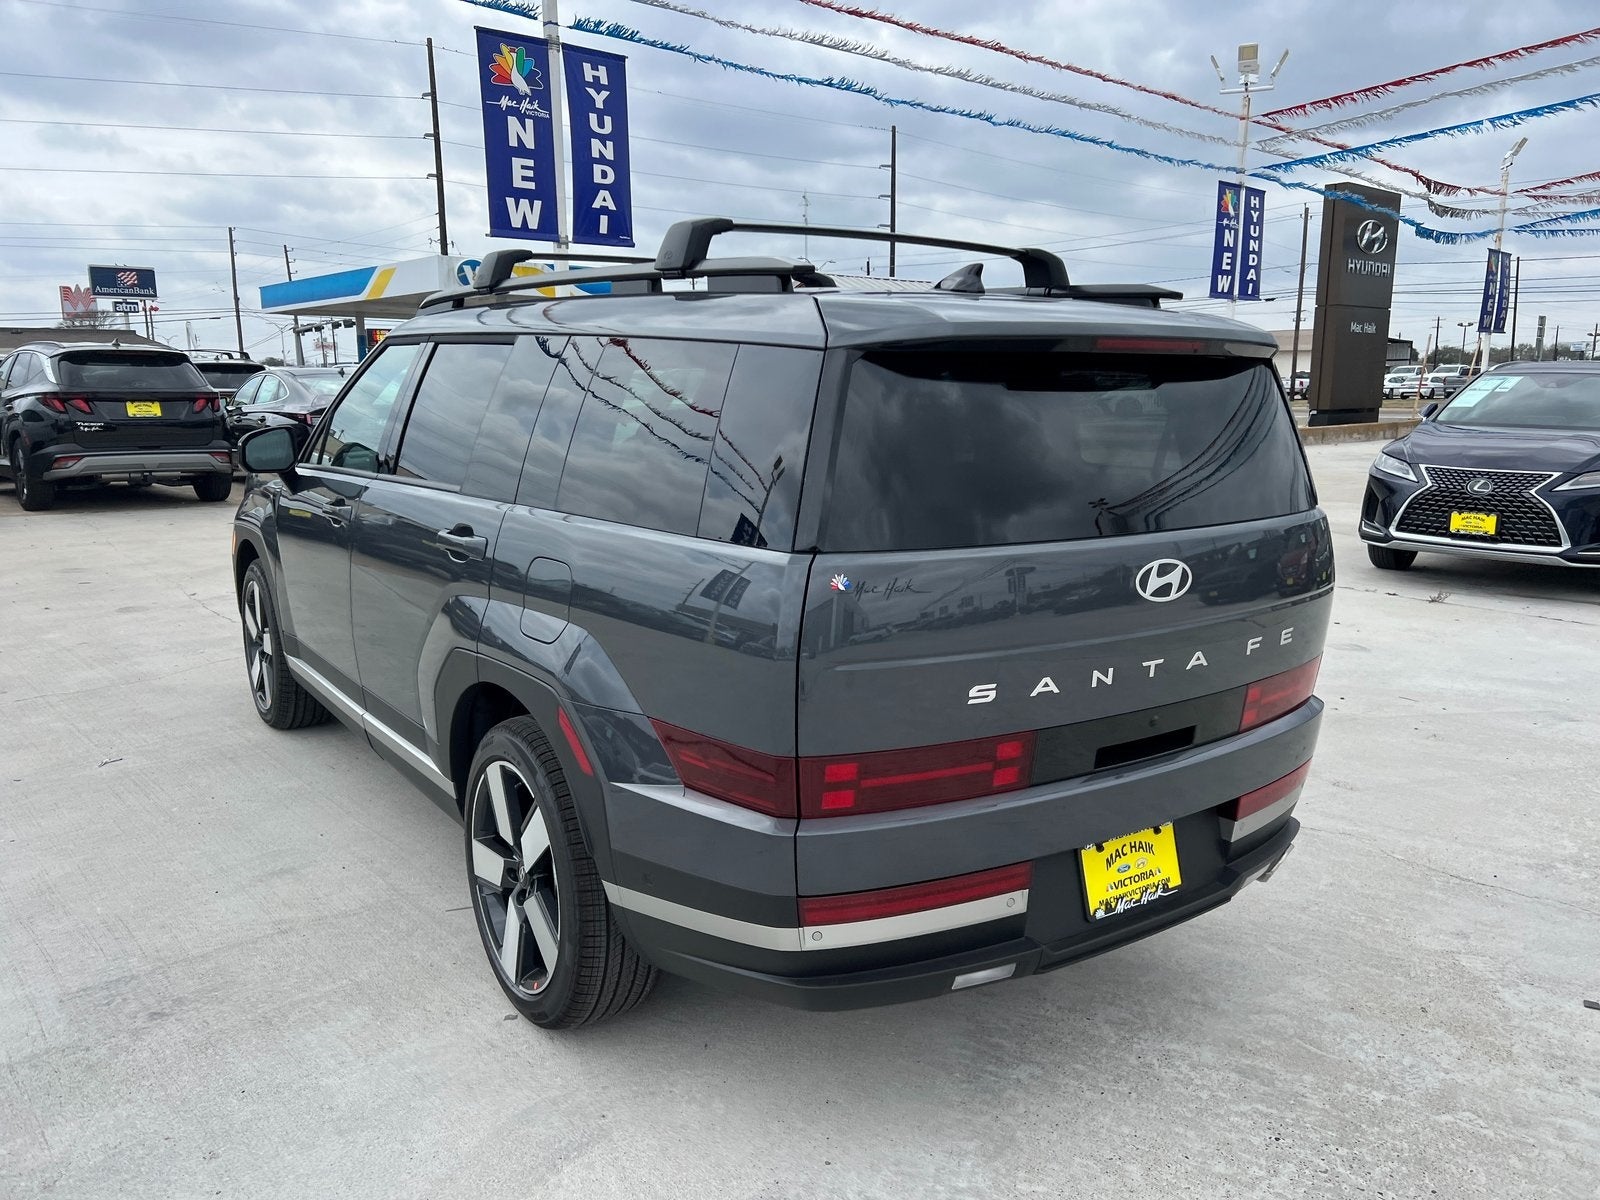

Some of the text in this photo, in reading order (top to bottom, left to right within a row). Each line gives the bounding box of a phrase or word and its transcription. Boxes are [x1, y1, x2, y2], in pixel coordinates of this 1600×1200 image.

[488, 95, 549, 114] Mac Haik
[525, 110, 550, 119] VICTORIA
[582, 62, 617, 234] HYUNDAI
[505, 115, 542, 230] NEW
[1246, 195, 1260, 295] HYUNDAI
[1217, 229, 1235, 293] NEW
[1347, 258, 1391, 277] HYUNDAI
[95, 285, 155, 295] AmericanBank
[1483, 282, 1496, 328] NEW
[1499, 256, 1510, 329] HYUNDAI
[115, 303, 138, 312] atm
[1350, 321, 1377, 334] Mac Haik
[850, 577, 931, 601] Mac Haik
[967, 627, 1294, 705] SANTA FE
[1105, 843, 1127, 871] MAC
[1129, 840, 1155, 856] HAIK
[1113, 869, 1155, 890] VICTORIA
[1108, 884, 1177, 915] Mac Haik
